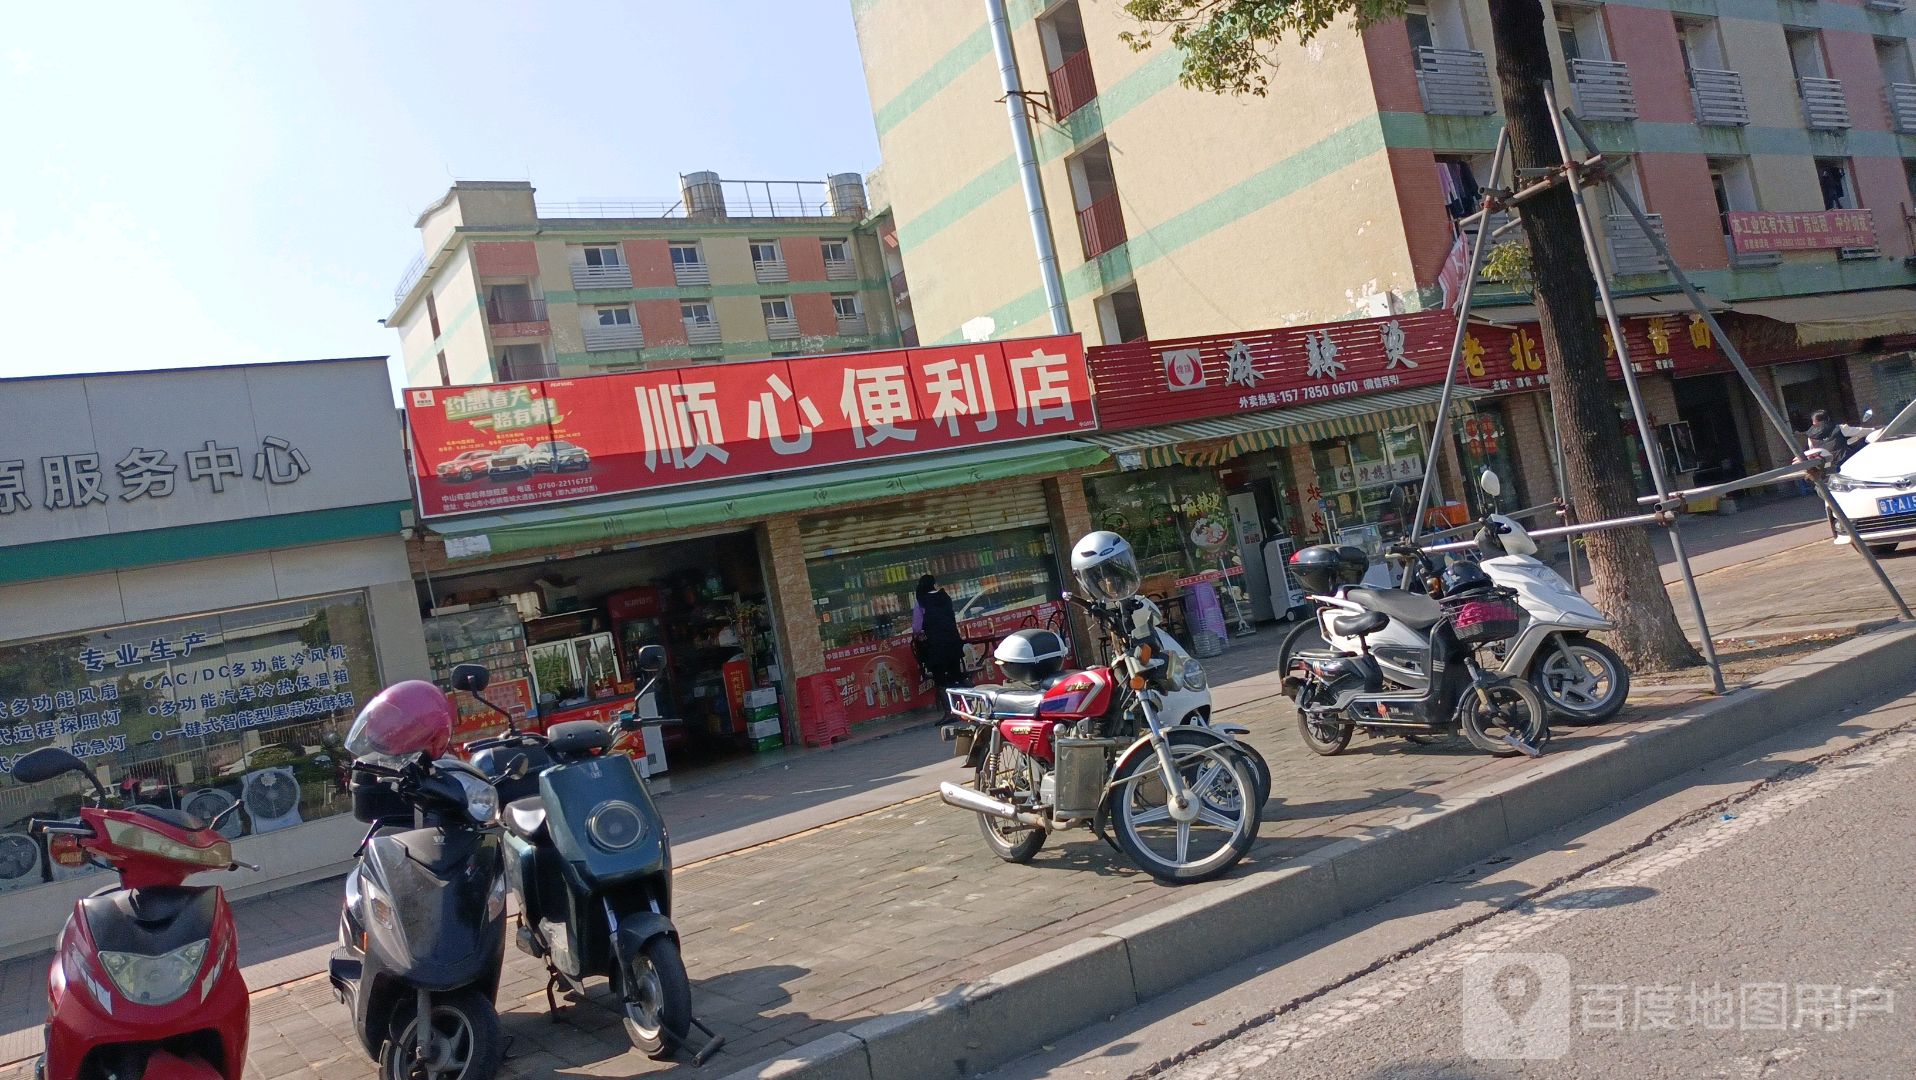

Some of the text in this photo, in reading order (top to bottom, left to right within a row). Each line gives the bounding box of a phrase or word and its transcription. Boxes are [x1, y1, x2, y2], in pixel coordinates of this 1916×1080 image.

[635, 348, 1076, 473] 顺心便利店
[1302, 385, 1329, 400] 7850
[1332, 381, 1358, 396] 0670
[79, 632, 207, 672] 专业生产
[160, 669, 349, 718] 多功能汽车冷热保温箱
[166, 692, 355, 738] 一键式智能型黑蒜发酵锅
